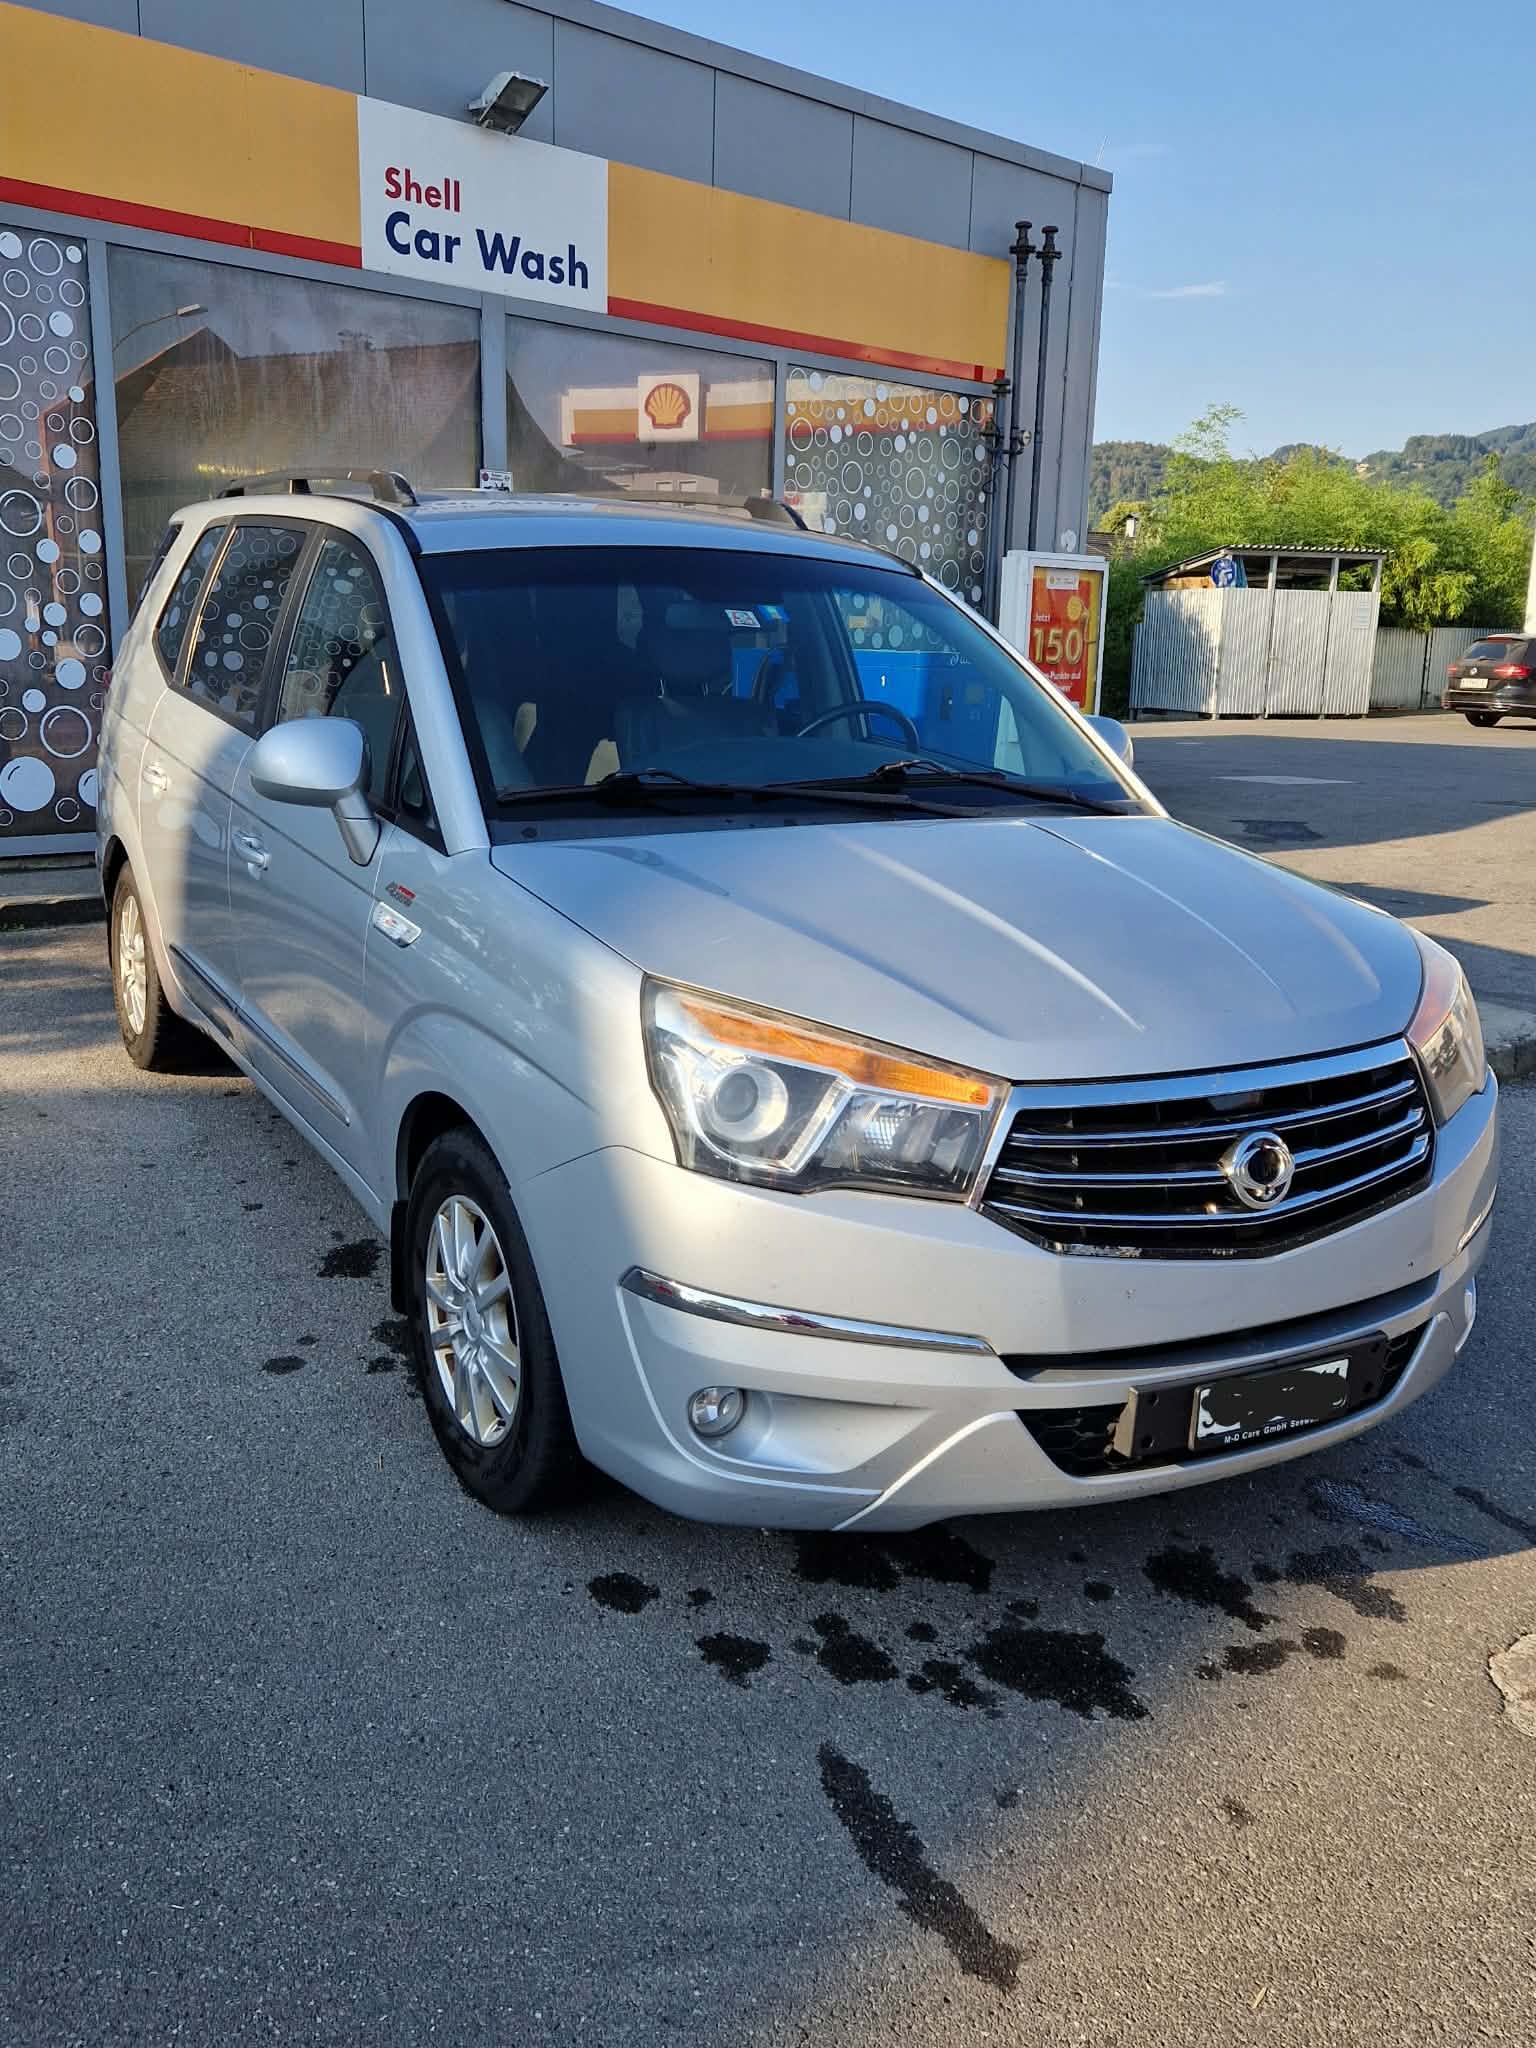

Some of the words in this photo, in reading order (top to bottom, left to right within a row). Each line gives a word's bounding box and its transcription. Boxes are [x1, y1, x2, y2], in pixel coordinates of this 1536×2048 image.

[385, 167, 460, 212] Shell
[385, 211, 461, 263] Car
[476, 229, 588, 289] Wash
[1033, 628, 1083, 665] 150
[1264, 1422, 1287, 1434] GmbH
